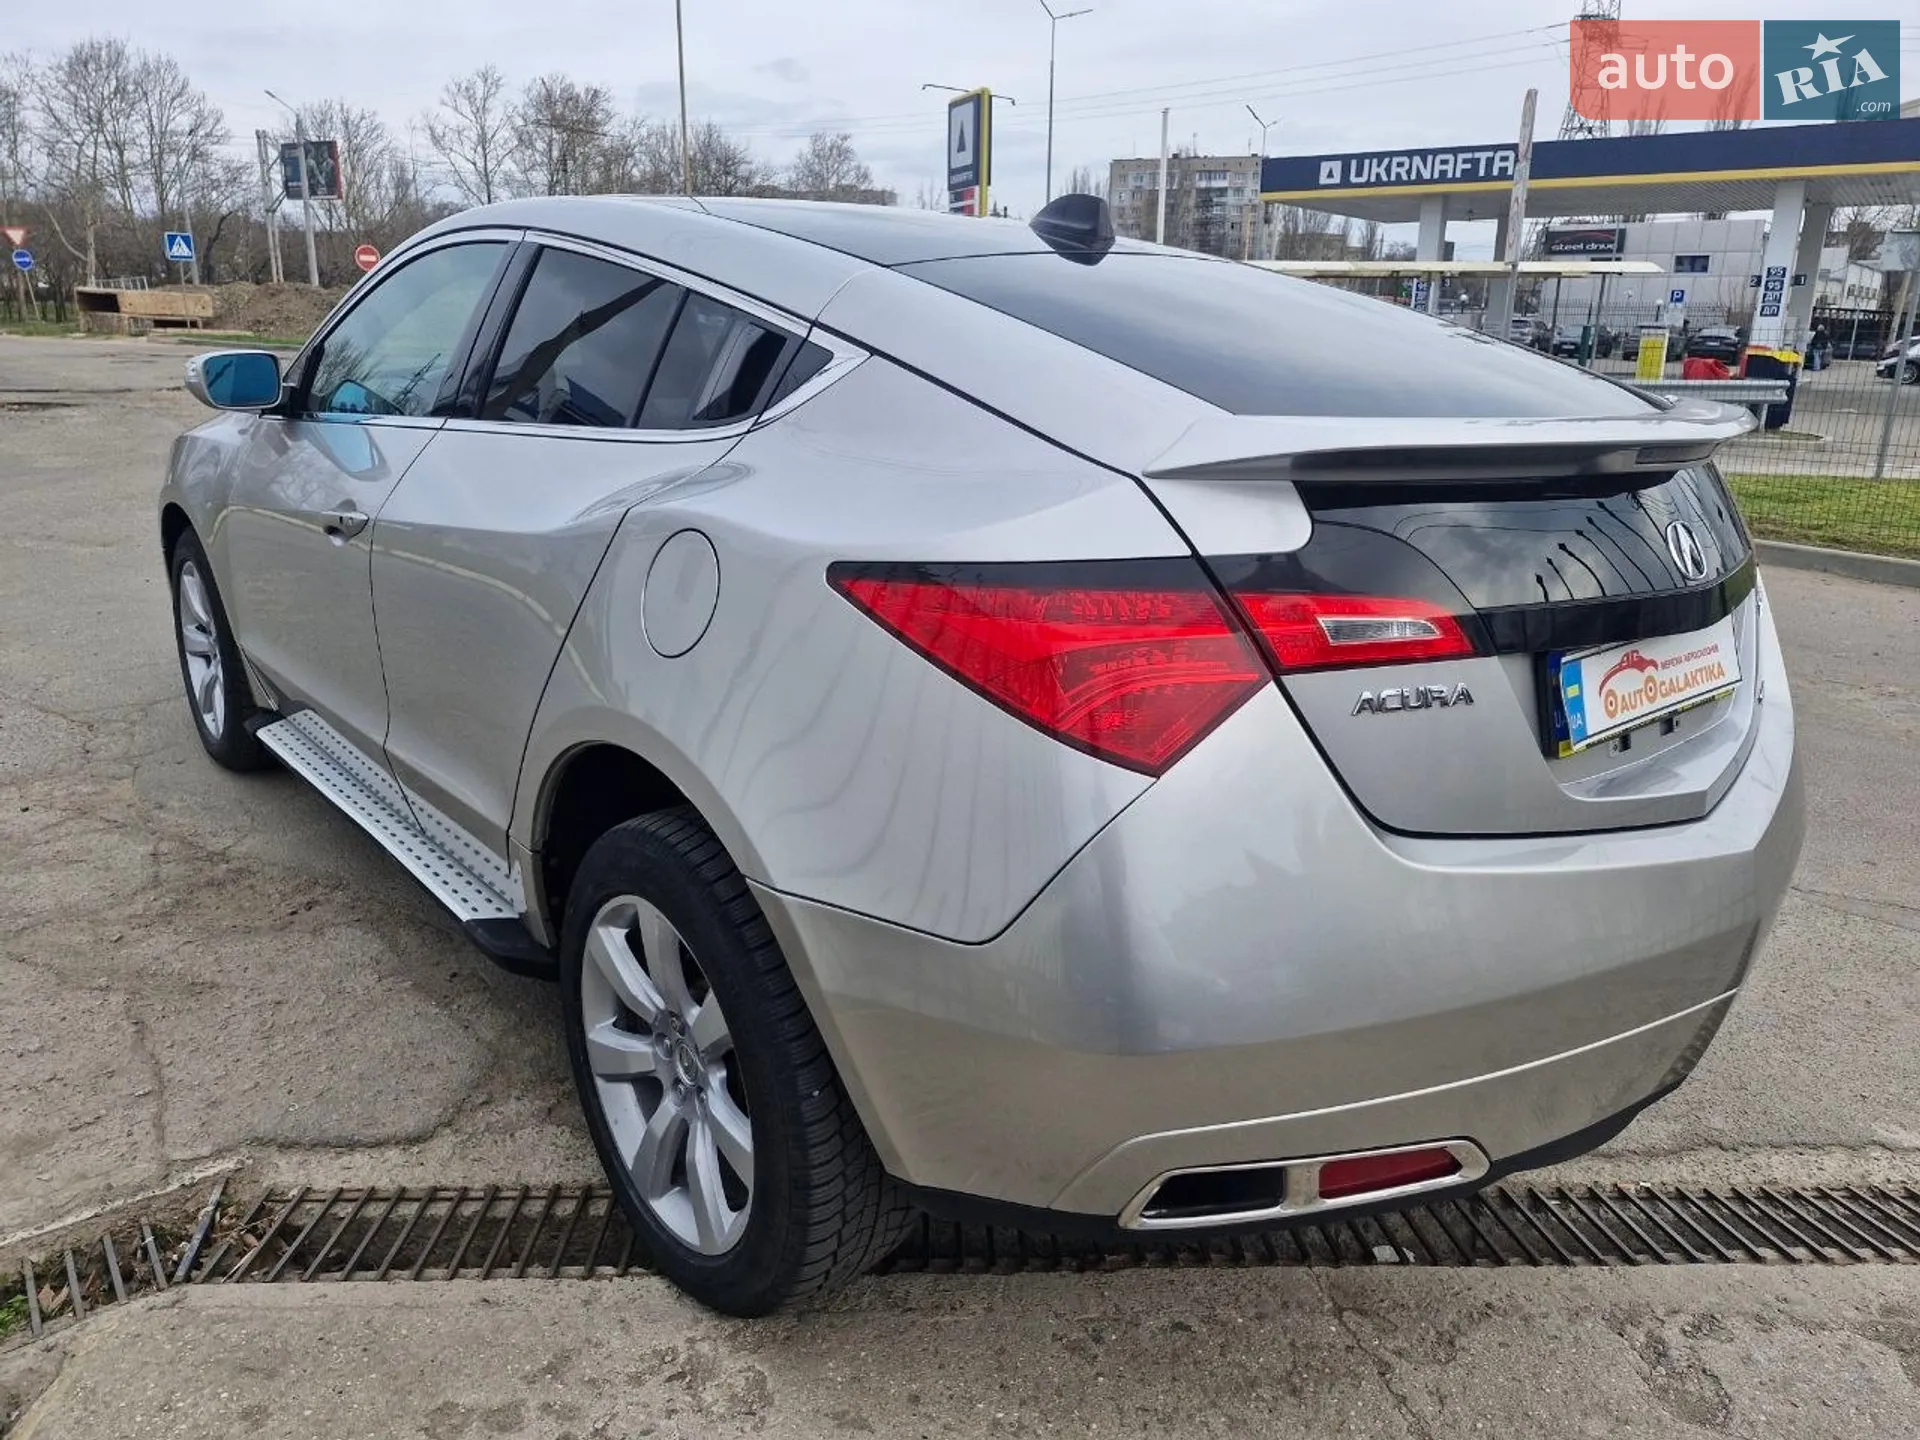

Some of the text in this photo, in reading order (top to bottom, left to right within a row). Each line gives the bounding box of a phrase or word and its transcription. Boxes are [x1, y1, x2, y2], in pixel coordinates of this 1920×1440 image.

[1350, 150, 1515, 184] UKRNAFTA
[1770, 266, 1783, 276] 95
[1768, 281, 1781, 291] 95
[1351, 682, 1474, 716] ACURA
